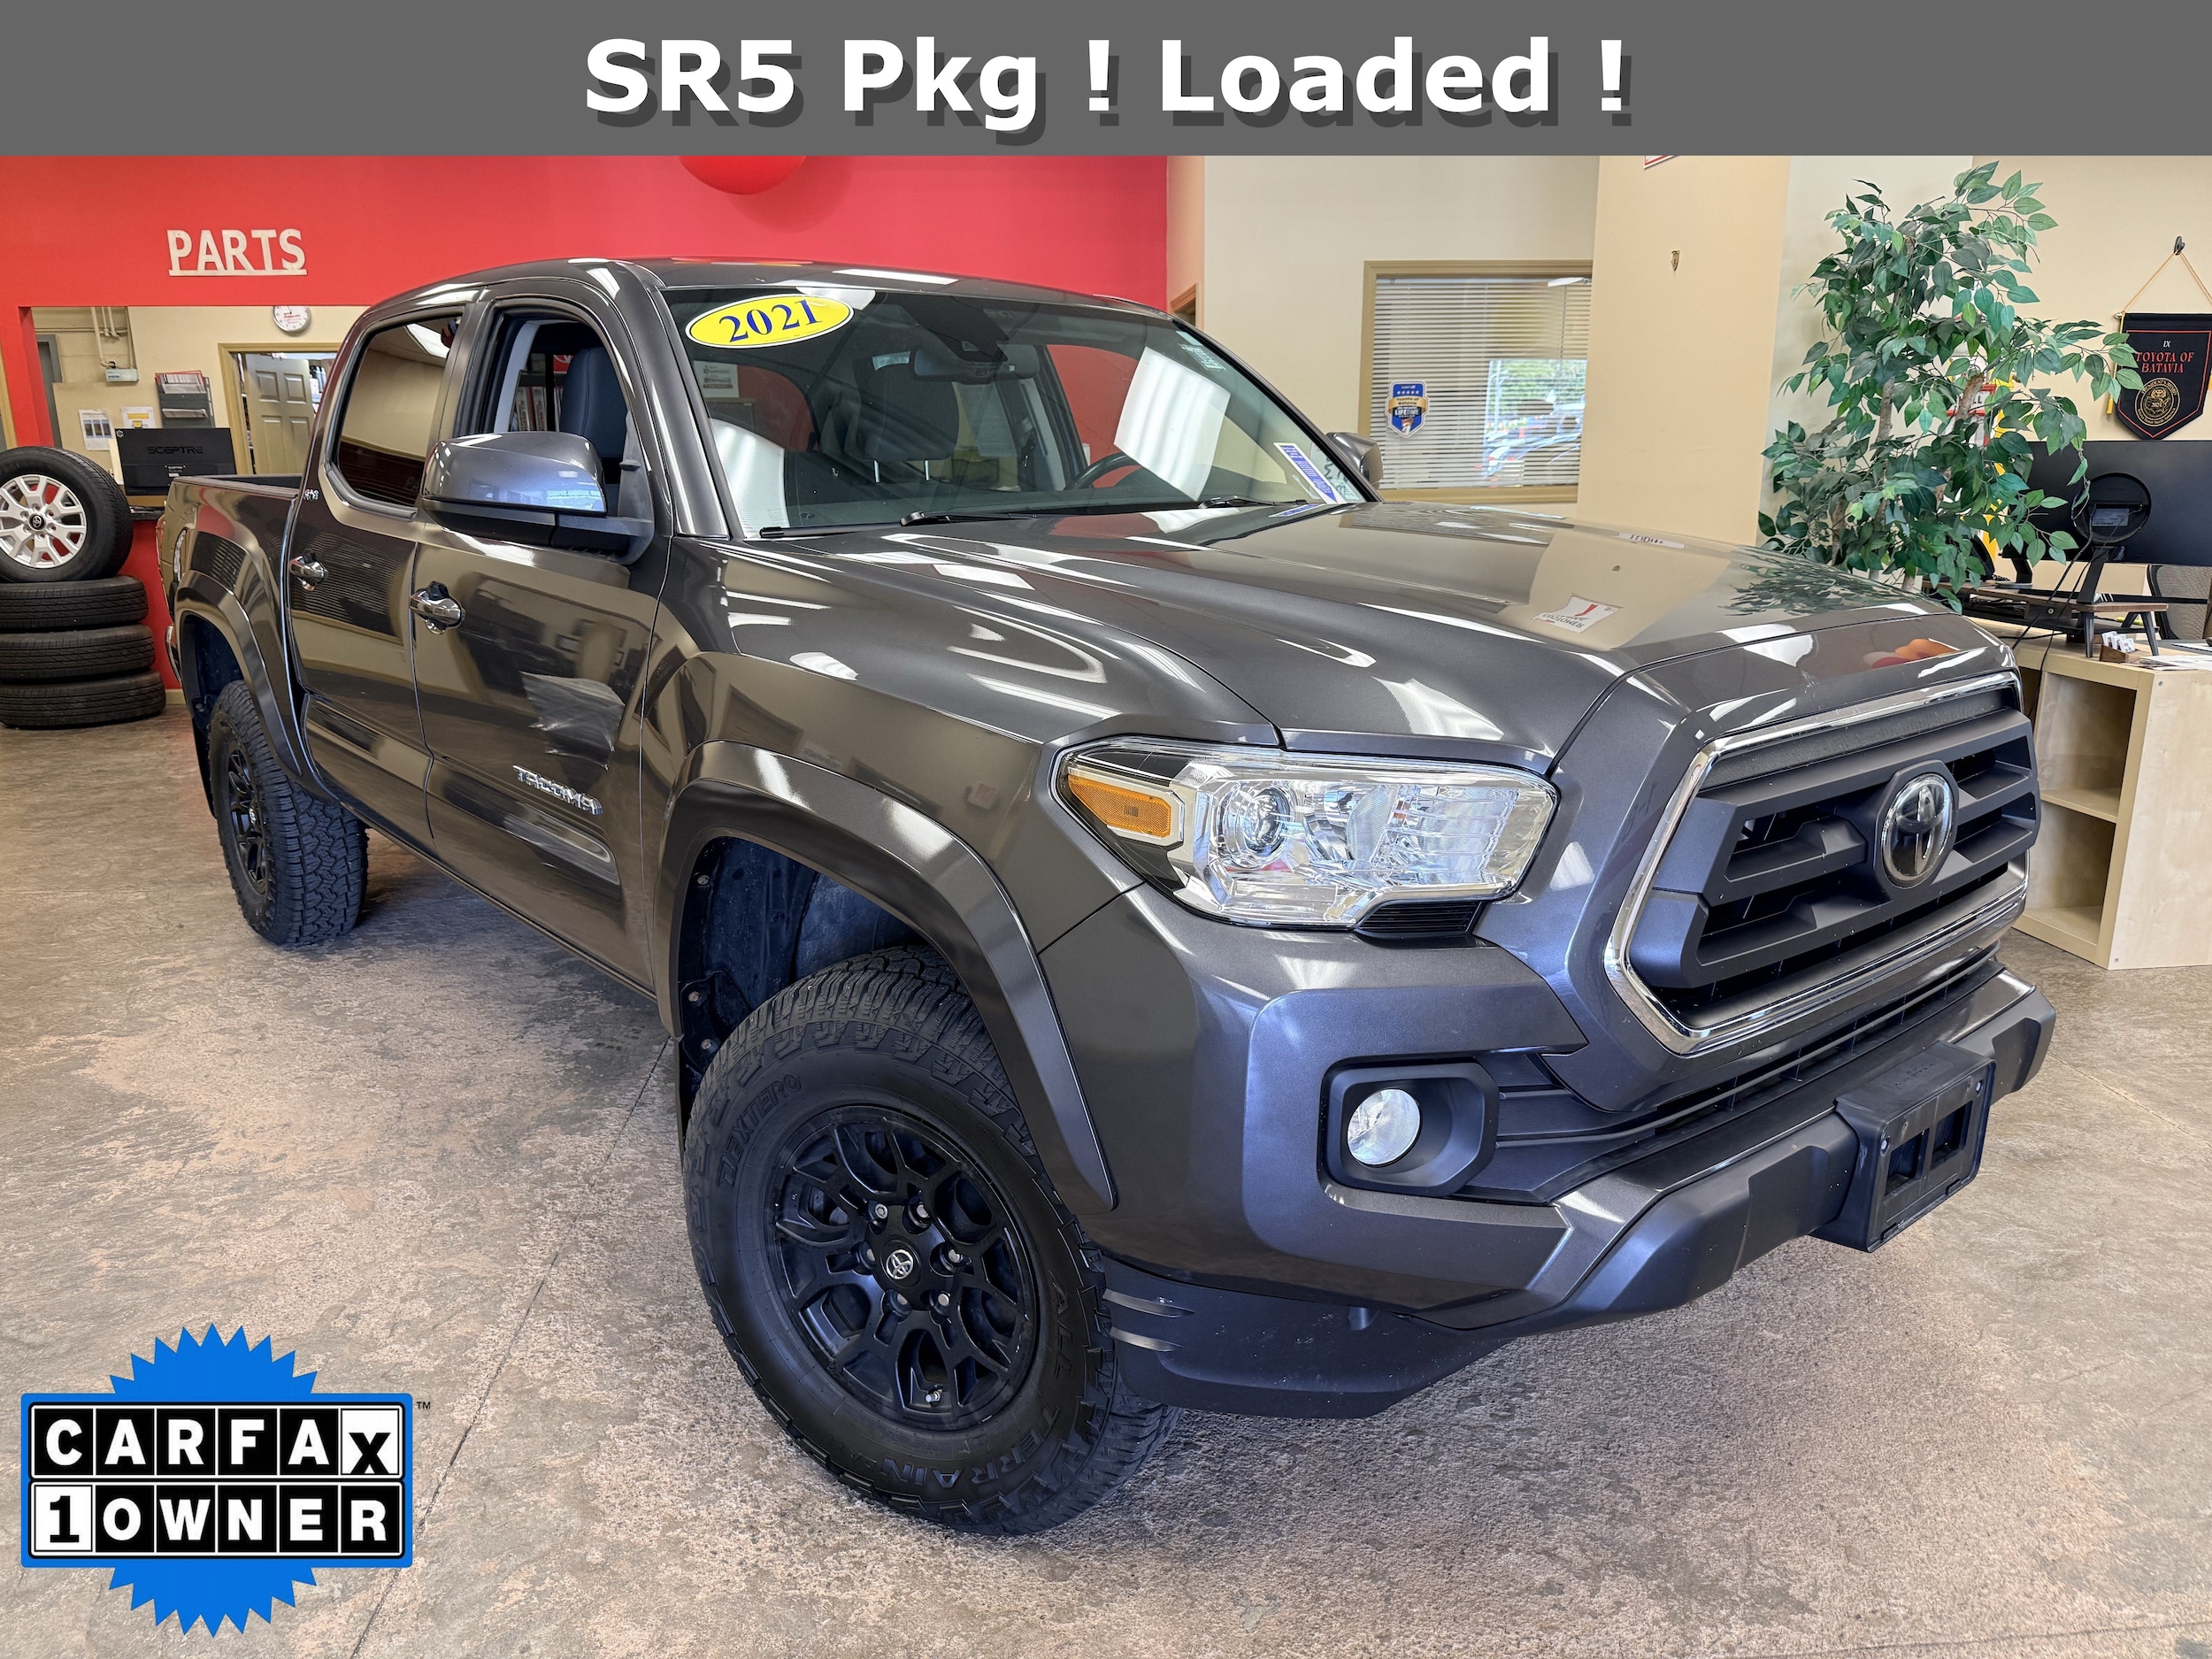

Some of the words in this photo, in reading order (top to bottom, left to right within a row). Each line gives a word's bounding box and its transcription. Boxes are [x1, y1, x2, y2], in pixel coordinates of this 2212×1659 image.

[166, 228, 307, 271] PARTS
[718, 299, 823, 342] 2021
[2137, 352, 2177, 363] TOYOTA
[2180, 352, 2194, 362] OF
[2141, 364, 2185, 373] BATAVIA
[718, 1073, 802, 1188] DEXTERO
[879, 1404, 1062, 1489] TERRAIN
